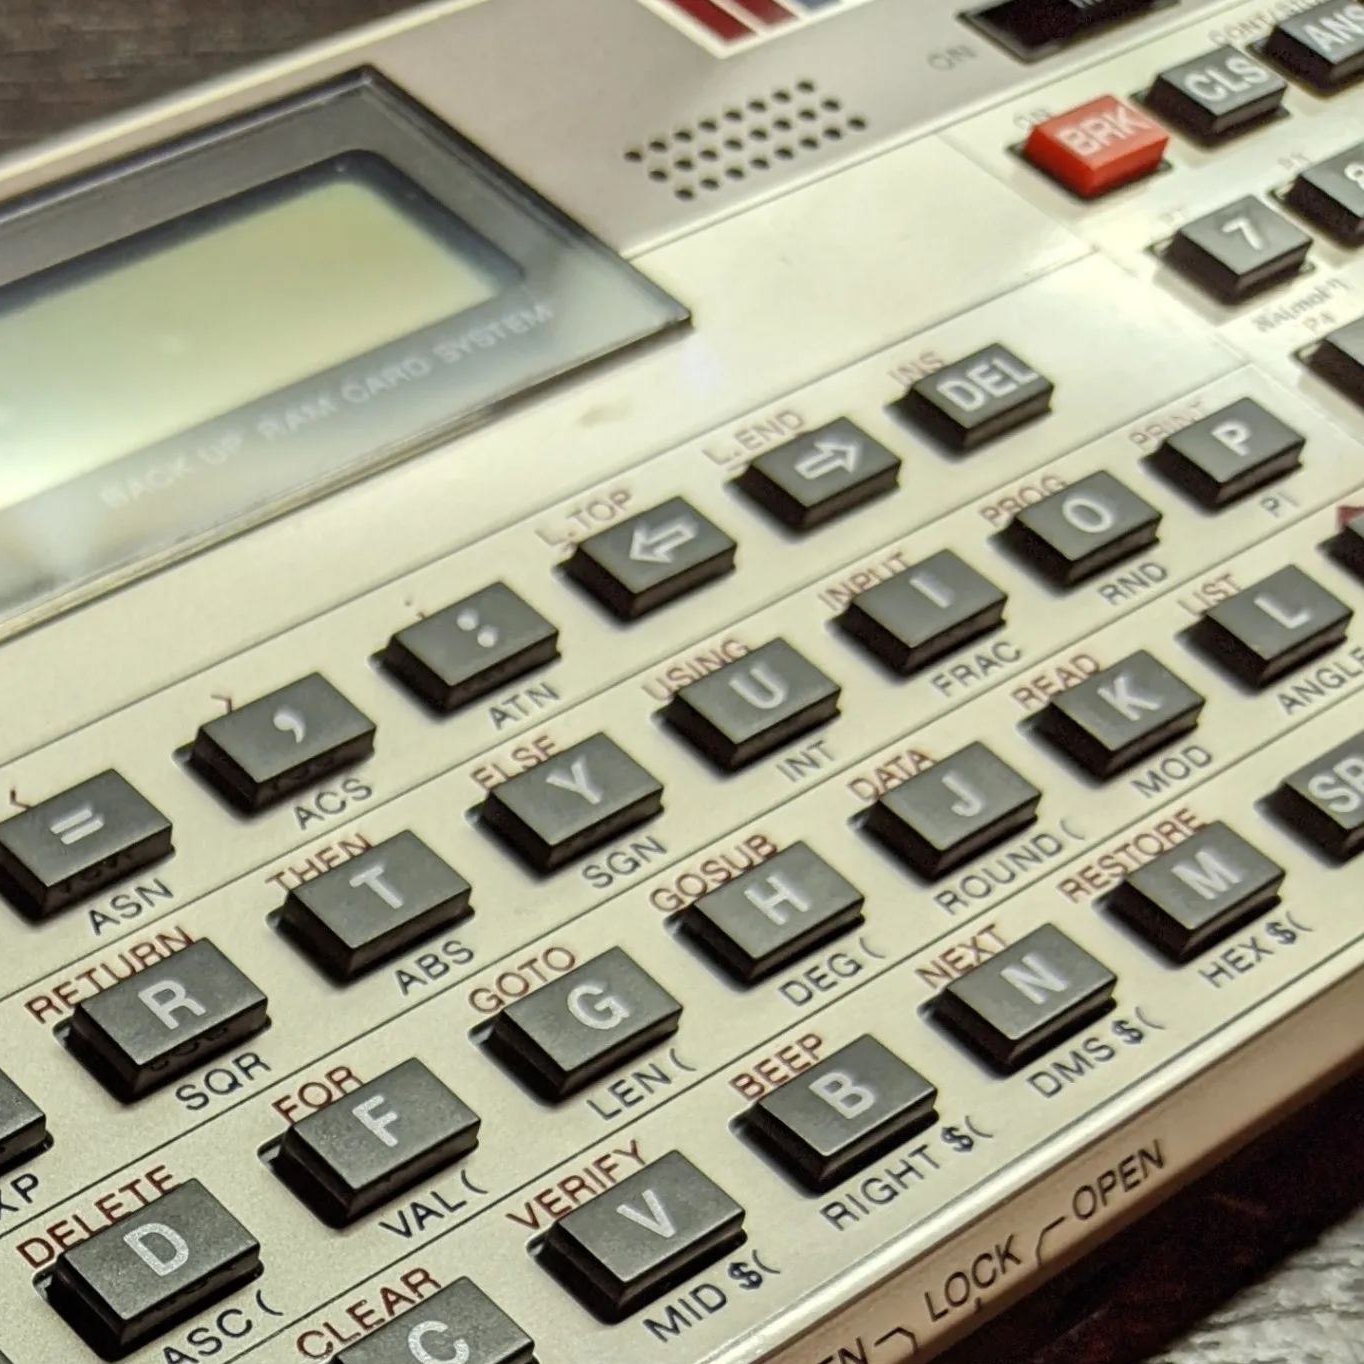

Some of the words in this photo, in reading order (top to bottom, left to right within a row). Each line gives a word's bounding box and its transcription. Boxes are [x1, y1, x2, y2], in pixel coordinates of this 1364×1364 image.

[1185, 56, 1271, 102] CLS
[1057, 101, 1153, 156] BRK
[1222, 216, 1265, 251] 7
[889, 349, 944, 386] INS
[940, 355, 1038, 411] DEL
[99, 456, 191, 508] BACK
[198, 428, 245, 465] UP
[258, 395, 337, 441] RAM
[343, 354, 432, 404] CARD
[433, 303, 554, 364] SYSTEM
[704, 410, 808, 468] L.END
[1210, 420, 1250, 457] P
[536, 489, 633, 545] L.TOP
[980, 471, 1068, 526] PROG
[819, 550, 913, 612] INPUT
[1100, 561, 1170, 607] RND
[1178, 573, 1241, 617] LIST
[1253, 596, 1310, 629] L
[640, 637, 750, 702] USING
[729, 663, 790, 710] U
[930, 639, 1024, 698] FRAC
[1011, 653, 1103, 713] READ
[1096, 670, 1162, 720] K
[489, 680, 561, 731] ATN
[470, 736, 558, 791] ELSE
[546, 760, 603, 805] Y
[776, 740, 839, 782] INT
[846, 747, 935, 804] DATA
[1130, 745, 1213, 797] MOD
[292, 777, 373, 830] ACS
[941, 774, 982, 820] J
[265, 833, 374, 894] THEN
[581, 835, 668, 889] SGN
[649, 833, 778, 913] GOSUB
[1056, 807, 1206, 904] RESTORE
[1171, 849, 1241, 899] M
[88, 878, 175, 936] ASN
[349, 864, 404, 909] T
[744, 874, 812, 925] H
[24, 927, 197, 1025] RETURN
[395, 940, 474, 996] ABS
[468, 946, 577, 1014] GOTO
[917, 924, 1009, 990] NEXT
[1000, 957, 1069, 1005] N
[137, 978, 207, 1030] R
[566, 983, 631, 1031] G
[176, 1051, 275, 1113] SQR
[271, 1065, 364, 1124] FOR
[730, 1034, 826, 1102] BEEP
[352, 1094, 399, 1147] F
[808, 1072, 877, 1122] B
[506, 1140, 648, 1233] VERIFY
[1070, 1141, 1167, 1222] OPEN
[17, 1166, 176, 1270] DELETE
[617, 1188, 676, 1240] V
[124, 1223, 190, 1277] D
[923, 1235, 1024, 1325] LOCK
[295, 1268, 442, 1363] CLEAR
